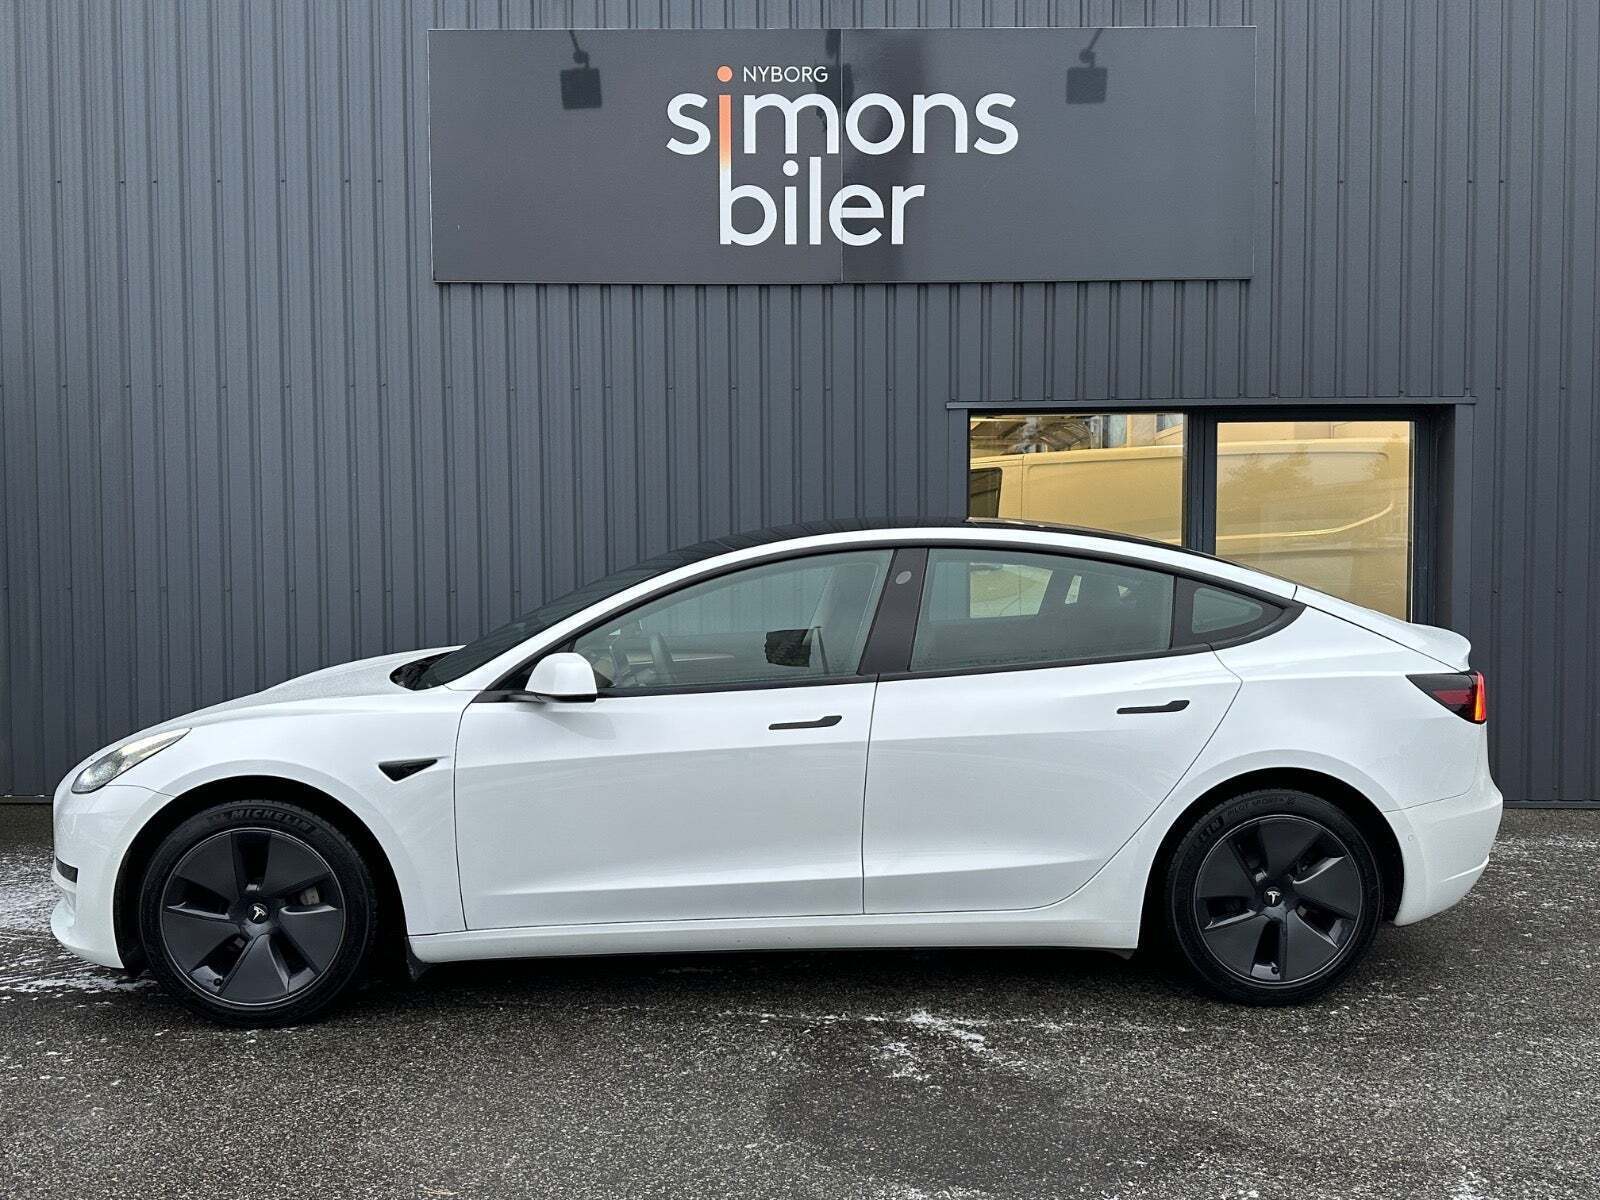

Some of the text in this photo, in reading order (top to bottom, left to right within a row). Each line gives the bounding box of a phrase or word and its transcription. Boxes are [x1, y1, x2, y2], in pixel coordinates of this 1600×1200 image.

[743, 66, 828, 83] NYBORG
[666, 66, 1019, 155] simons
[719, 156, 926, 246] biler
[231, 808, 314, 833] MICHELIN
